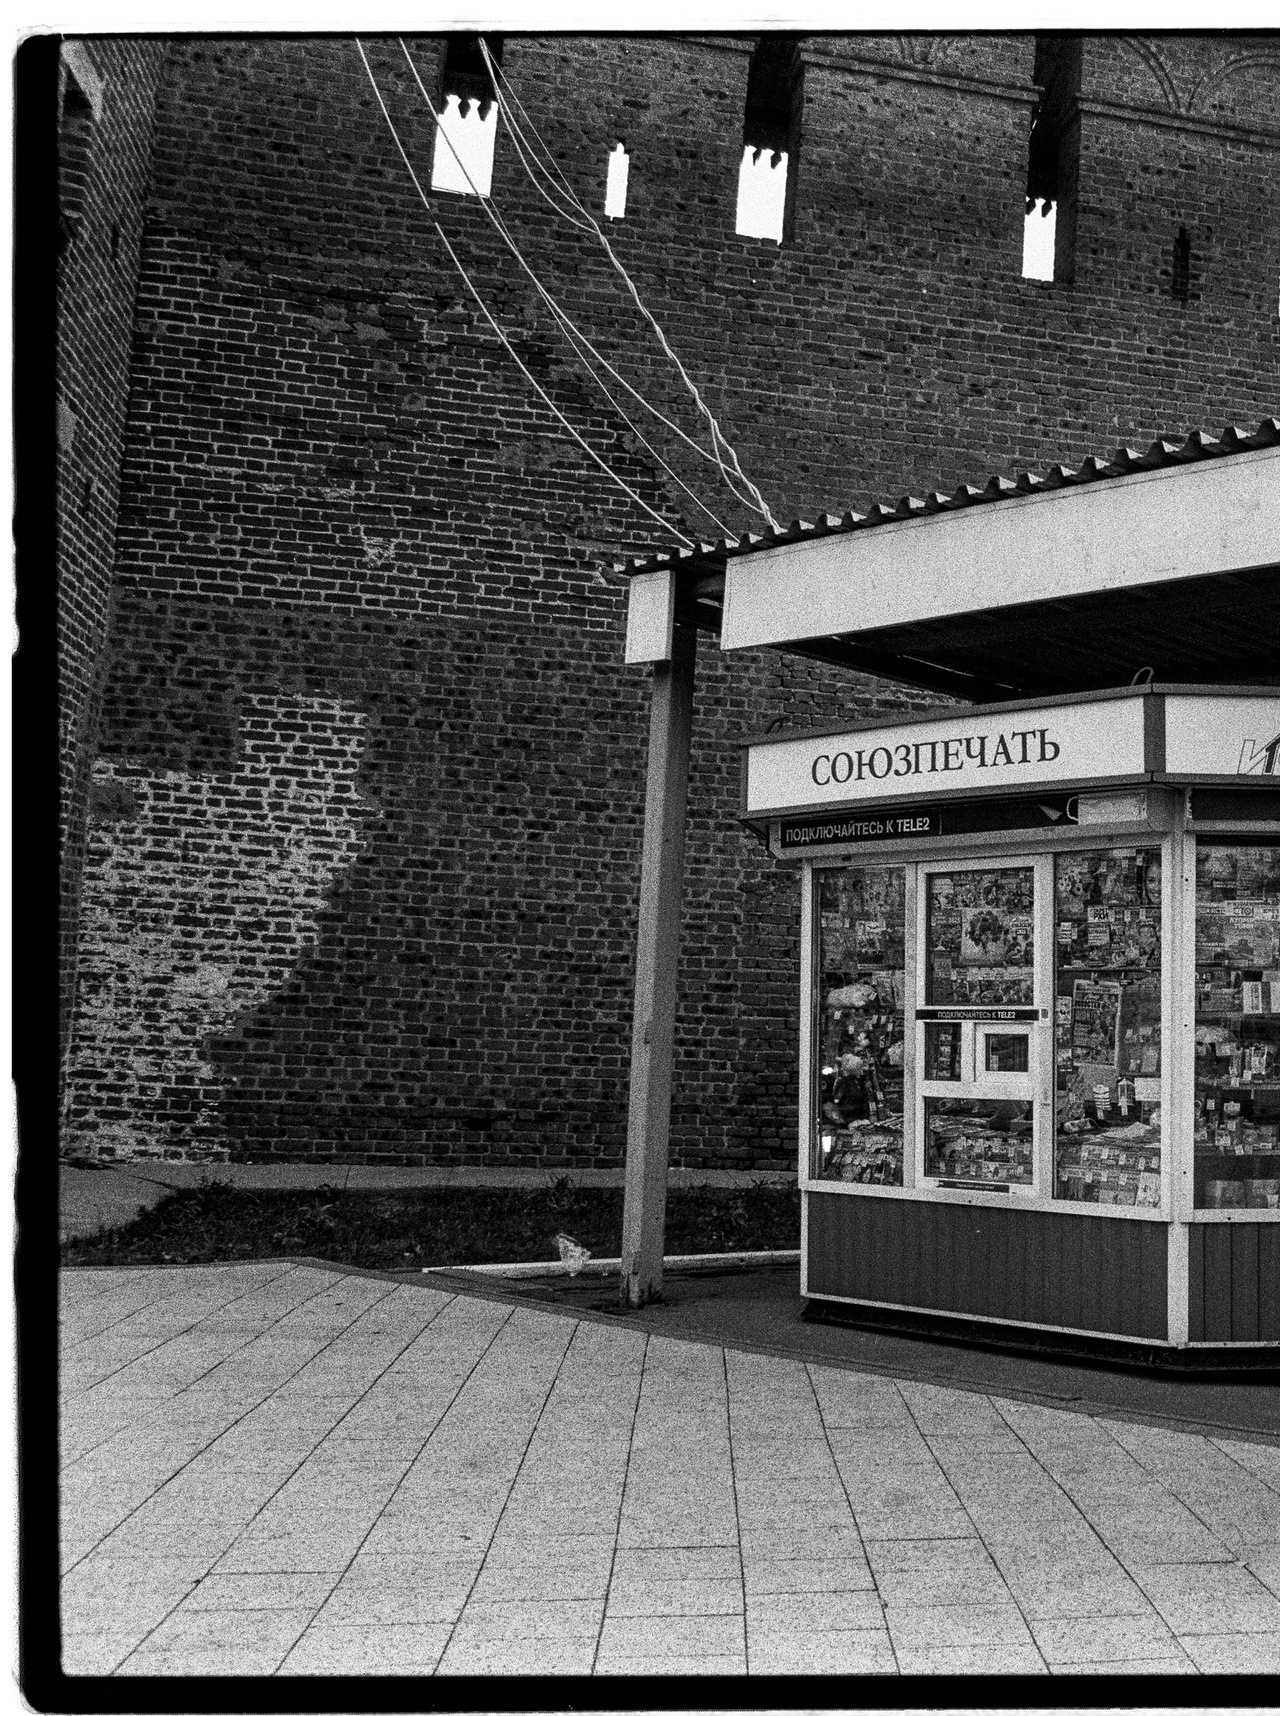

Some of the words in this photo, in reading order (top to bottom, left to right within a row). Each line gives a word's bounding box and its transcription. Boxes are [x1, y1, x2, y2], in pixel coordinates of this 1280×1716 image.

[811, 728, 1060, 785] СОЮЗПЕЧАТЬ
[786, 816, 884, 844] ПОДКЛЮЧАЙТЕСЬ
[897, 812, 930, 832] TELE2
[938, 1010, 991, 1019] ПОДКЛЮЧАЙТЕСЬ
[998, 1011, 1016, 1019] TELE2
